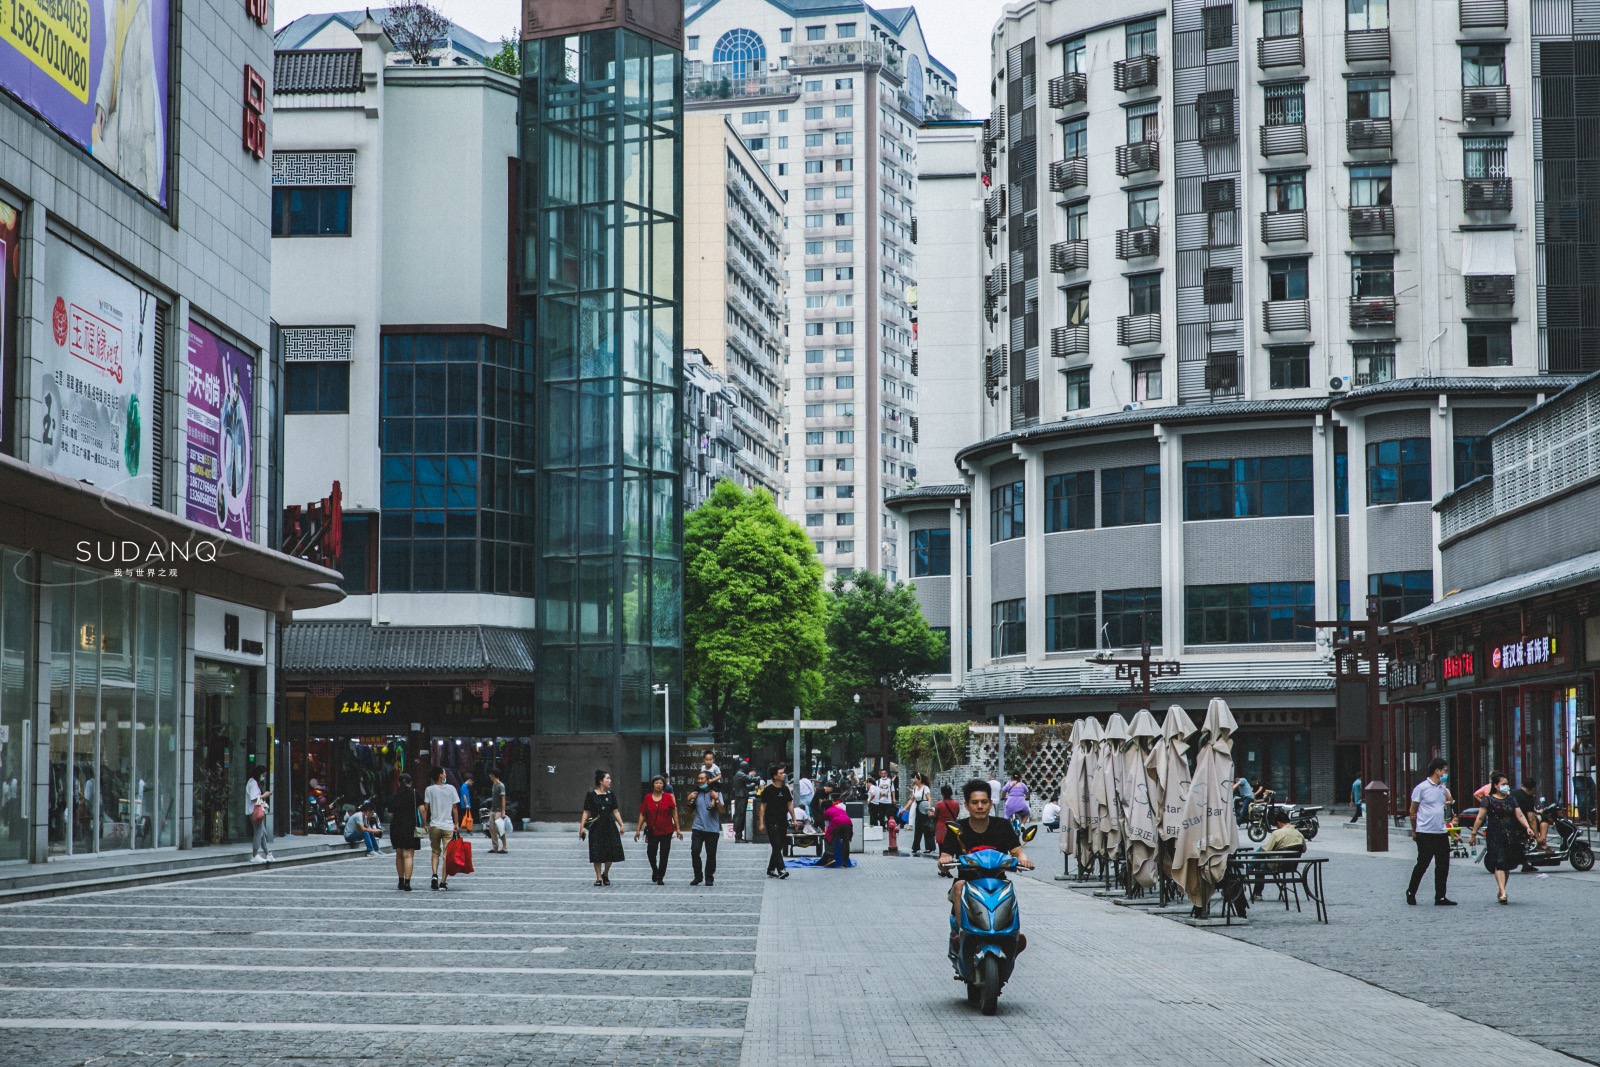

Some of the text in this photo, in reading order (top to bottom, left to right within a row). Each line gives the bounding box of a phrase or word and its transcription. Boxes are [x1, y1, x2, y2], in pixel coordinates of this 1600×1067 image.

[341, 701, 391, 714] 石山服装厂
[1182, 815, 1203, 830] Star
[1207, 807, 1223, 816] Bar
